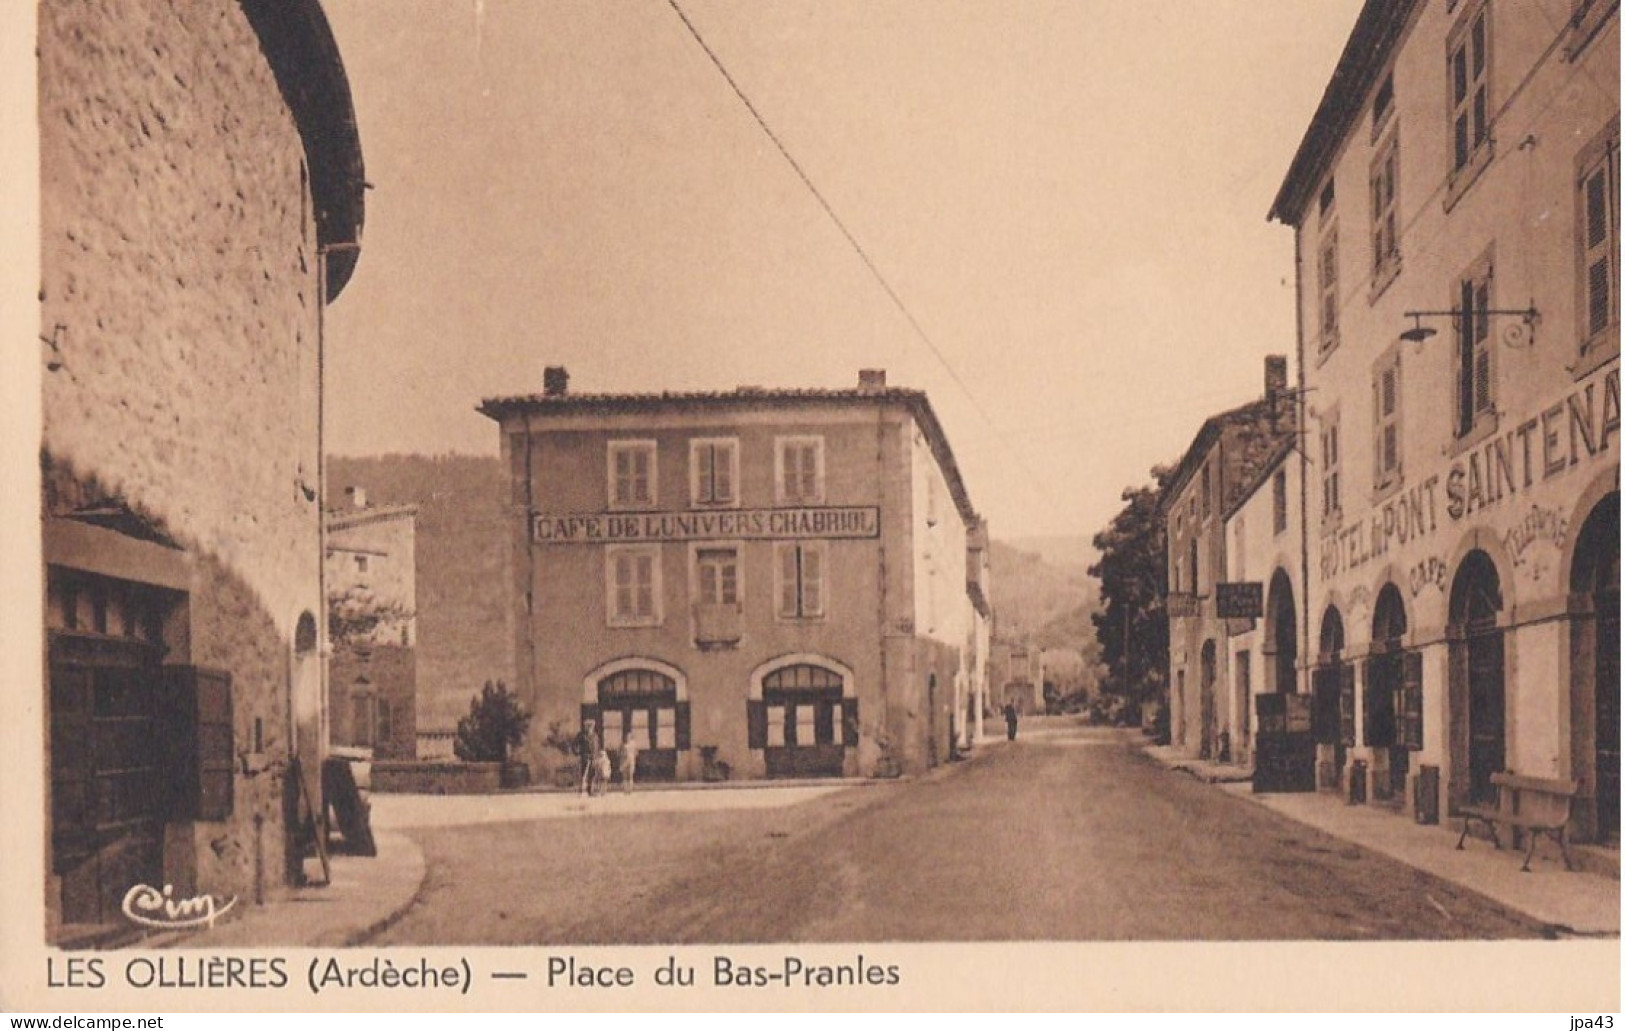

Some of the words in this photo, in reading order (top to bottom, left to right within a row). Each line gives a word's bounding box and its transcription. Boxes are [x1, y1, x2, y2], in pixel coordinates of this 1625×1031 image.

[607, 516, 640, 539] DE
[769, 510, 874, 535] CHABRIOL
[1383, 473, 1438, 553] PONT
